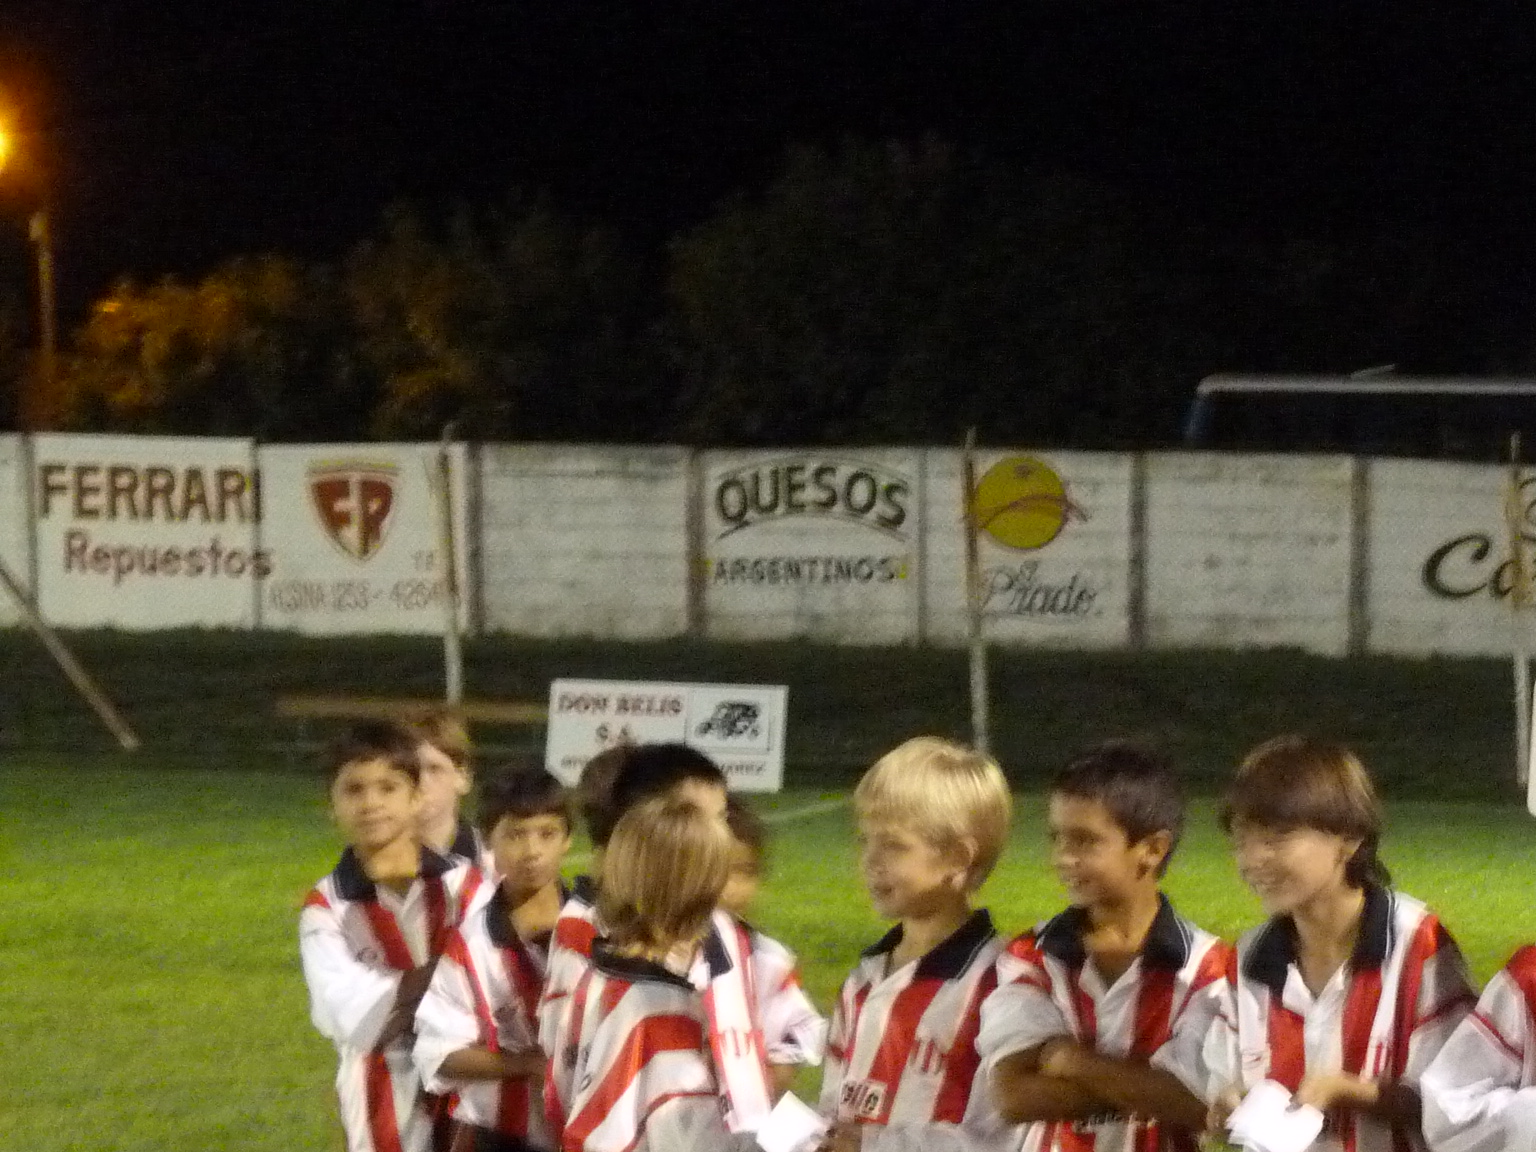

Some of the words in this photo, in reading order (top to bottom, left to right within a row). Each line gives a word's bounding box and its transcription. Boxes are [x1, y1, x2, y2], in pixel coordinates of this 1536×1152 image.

[714, 463, 908, 528] QUESOS
[63, 530, 276, 588] Repuestos
[712, 556, 897, 585] ARGENTINOS
